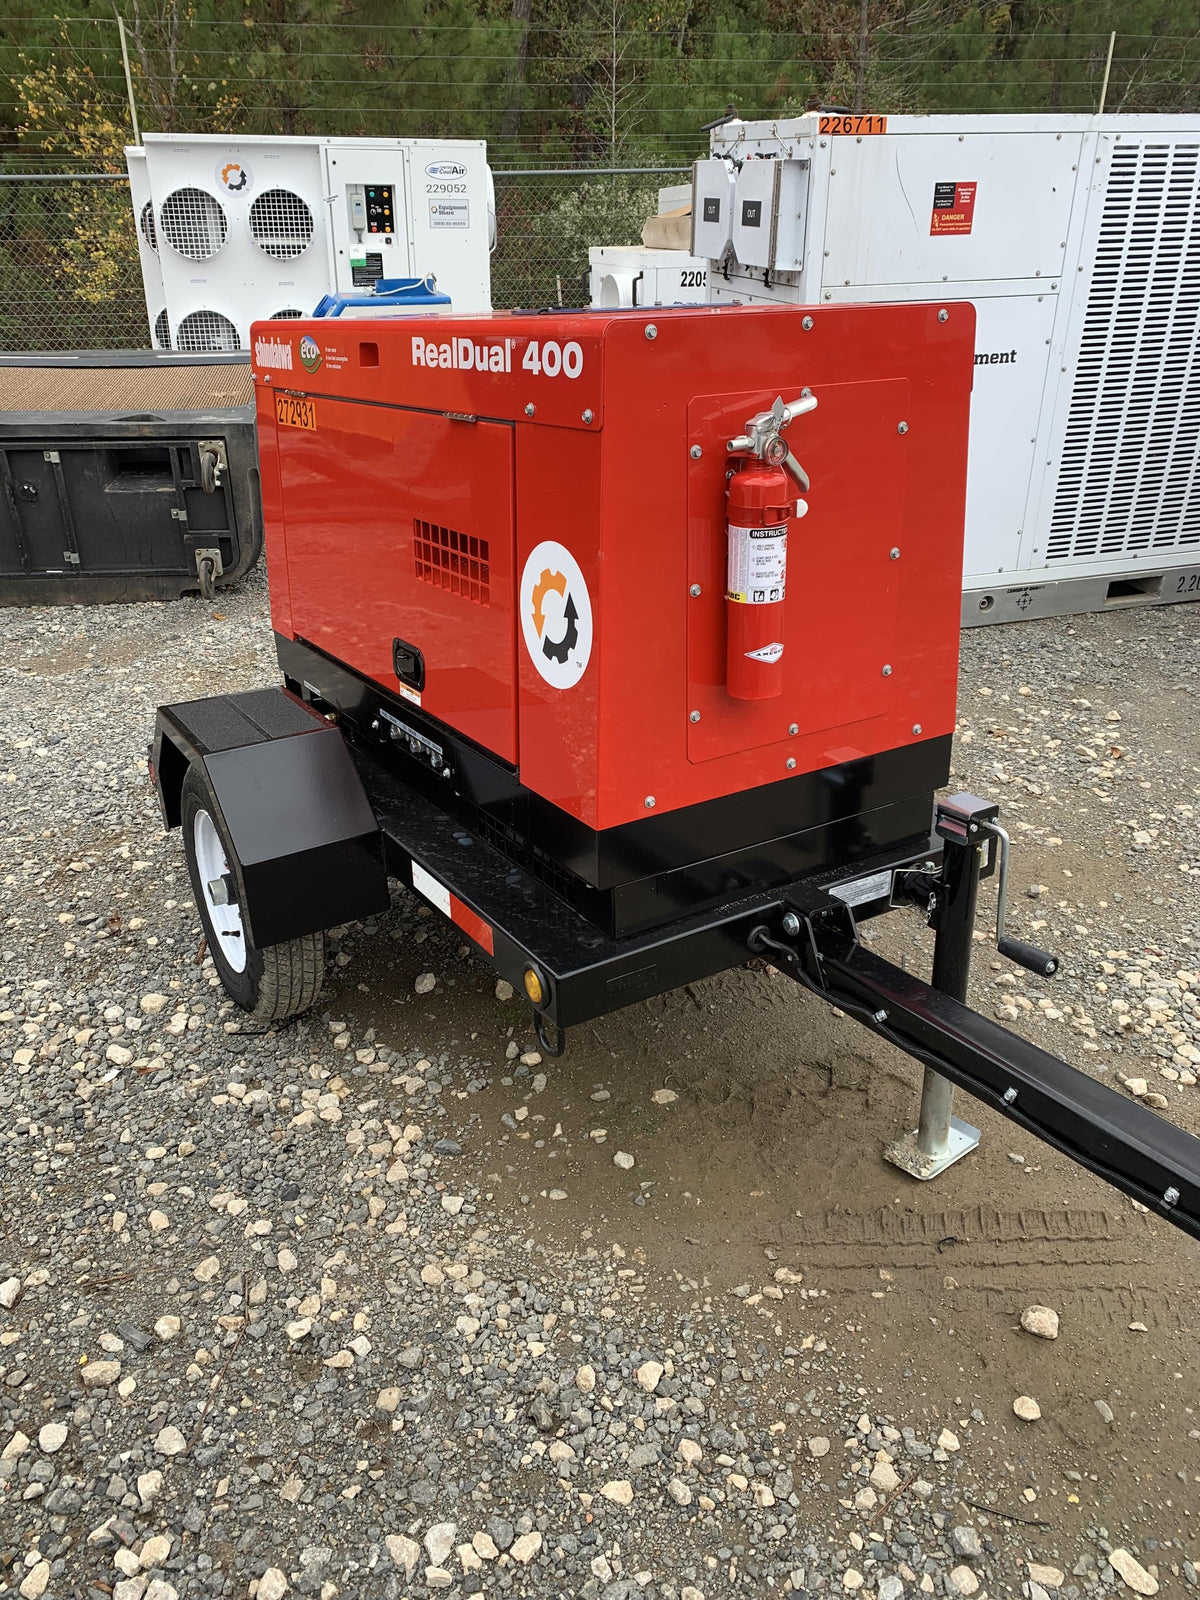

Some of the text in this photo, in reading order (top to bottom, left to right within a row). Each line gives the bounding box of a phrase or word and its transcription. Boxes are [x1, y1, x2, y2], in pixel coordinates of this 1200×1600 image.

[820, 116, 884, 133] 226711
[425, 184, 467, 193] 229052
[707, 205, 716, 214] OUT
[747, 209, 756, 218] OUT
[254, 336, 293, 370] shindaiwa
[522, 340, 584, 379] 400
[277, 398, 315, 429] 272931
